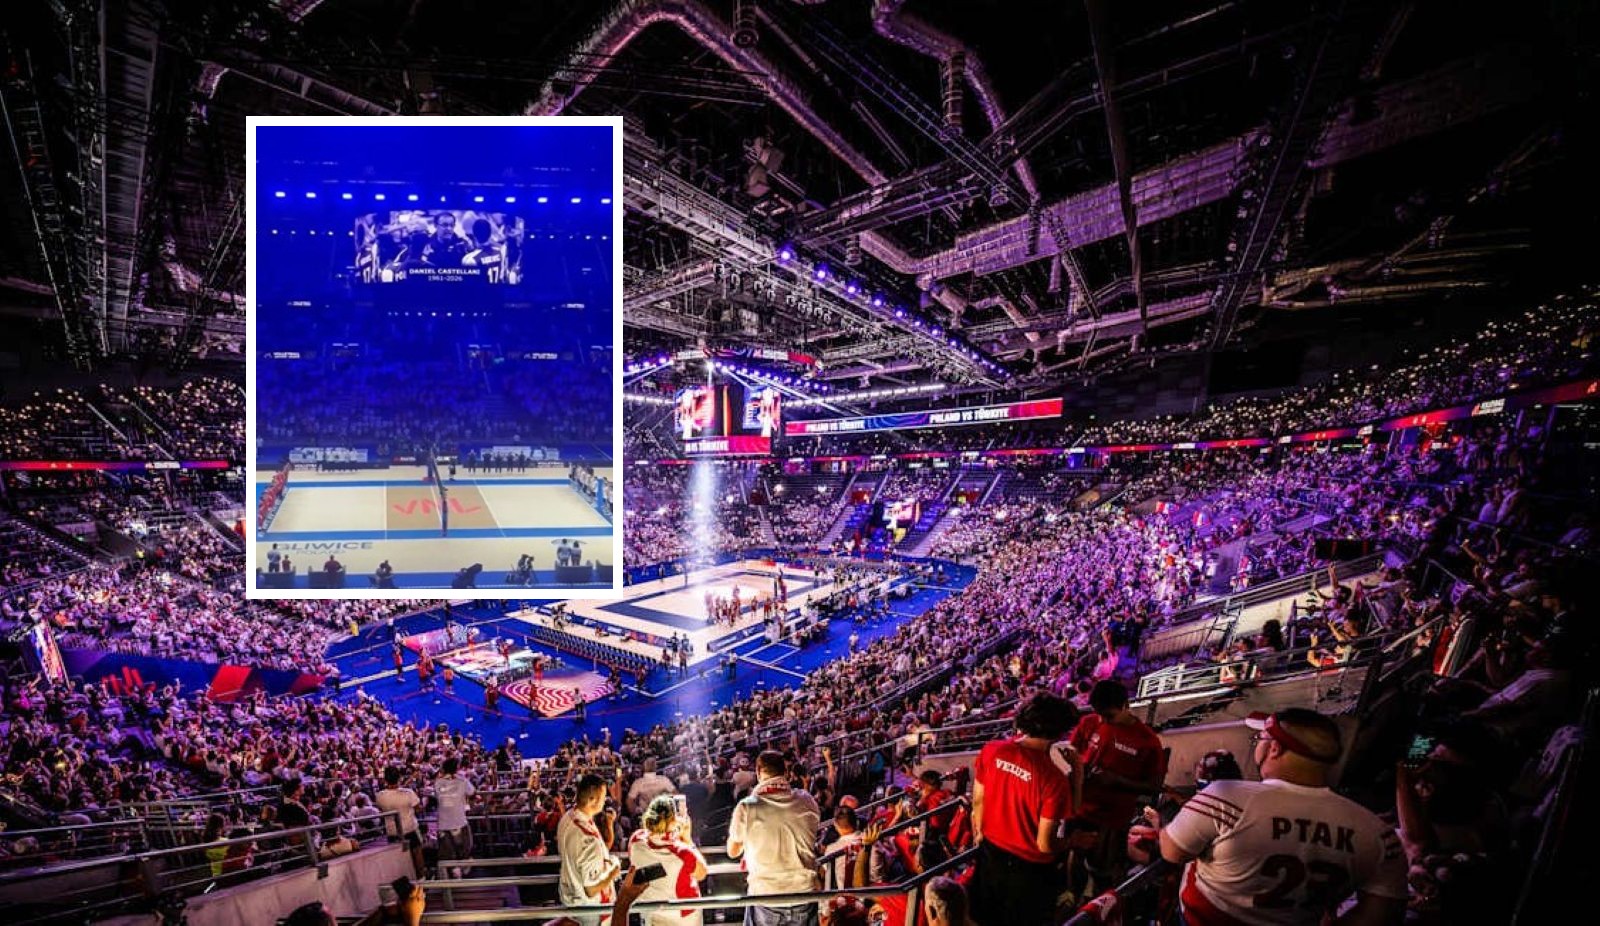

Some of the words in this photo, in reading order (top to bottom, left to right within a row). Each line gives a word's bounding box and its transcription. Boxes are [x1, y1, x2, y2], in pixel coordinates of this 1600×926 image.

[930, 412, 960, 424] POLAND
[961, 410, 974, 421] VS
[805, 422, 829, 433] POLAND
[995, 757, 1033, 782] VELUX
[1272, 816, 1356, 854] PTAK
